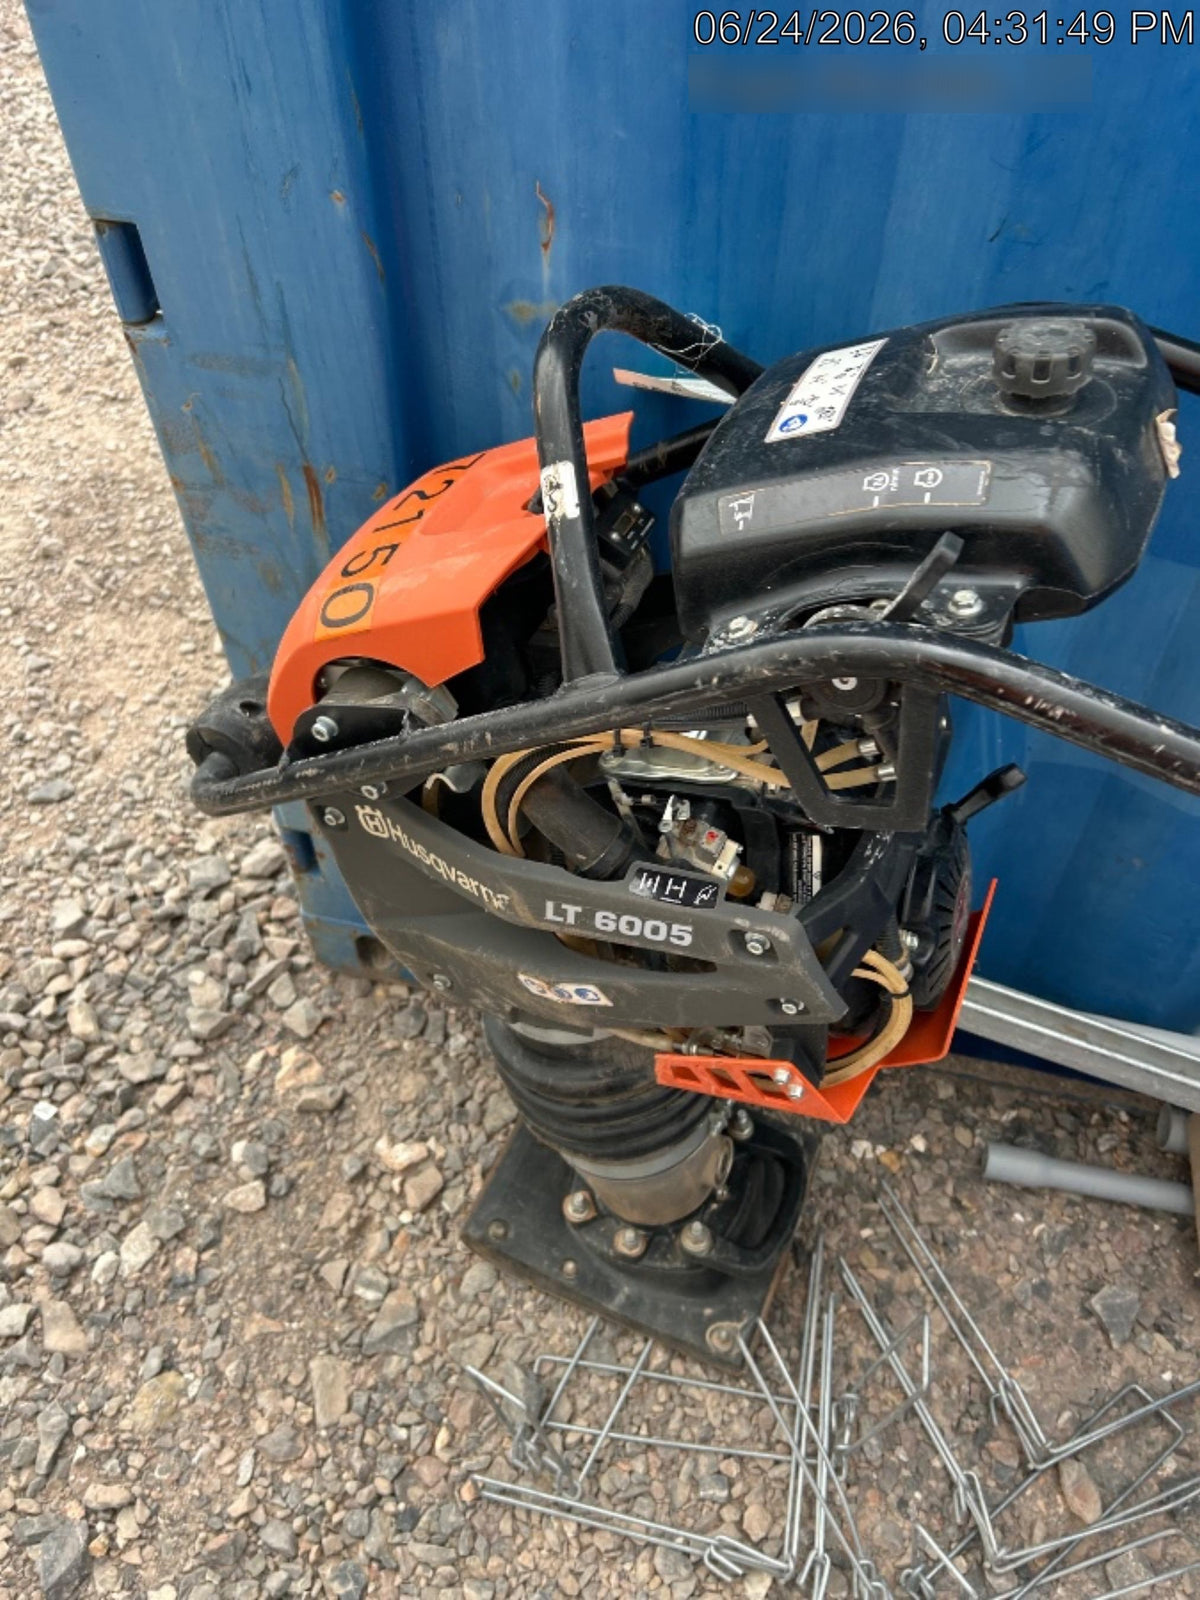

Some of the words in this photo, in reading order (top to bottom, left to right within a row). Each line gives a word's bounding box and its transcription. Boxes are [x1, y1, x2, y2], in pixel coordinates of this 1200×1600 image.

[386, 817, 511, 912] Husqvarna
[544, 900, 585, 926] LT
[593, 908, 694, 947] 6005
